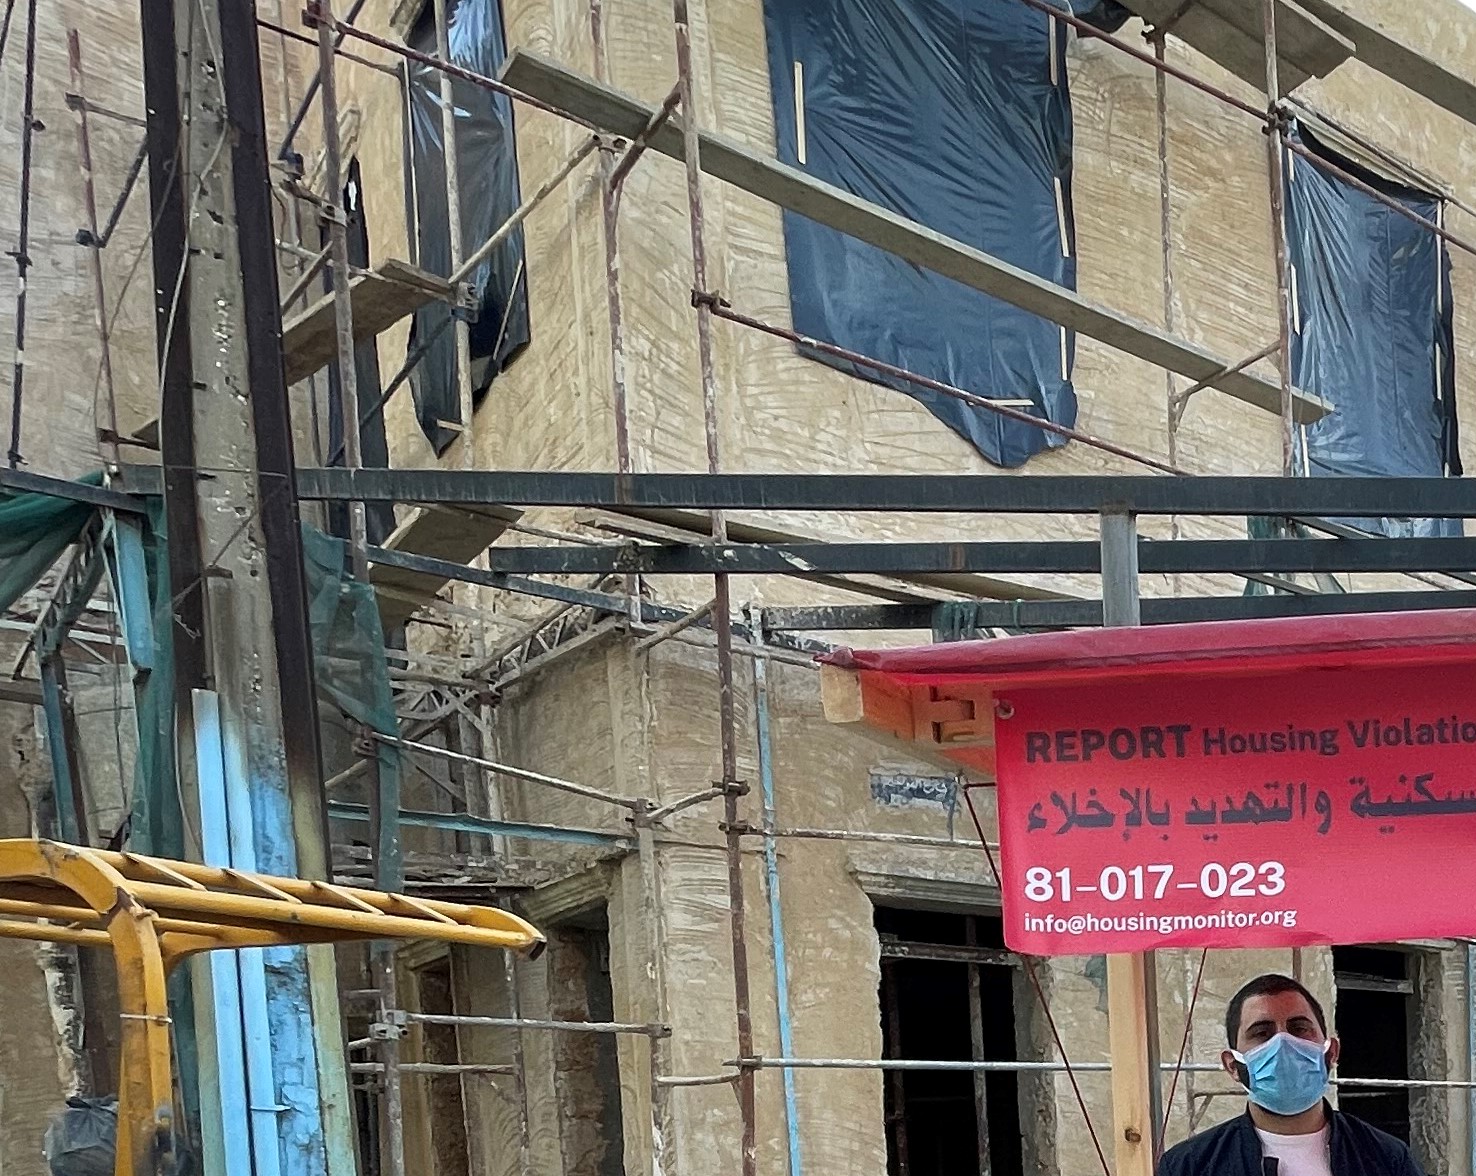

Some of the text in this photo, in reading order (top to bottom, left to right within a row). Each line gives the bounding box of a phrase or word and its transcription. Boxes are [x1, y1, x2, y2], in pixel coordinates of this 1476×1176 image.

[1026, 724, 1191, 763] REPORT
[1202, 724, 1340, 756] Housing
[1026, 786, 1172, 841] بالإخلاء
[1185, 781, 1333, 842] والتهديد
[1024, 861, 1287, 902] 81-017-023
[1024, 908, 1298, 935] info@housingmonitor.org
